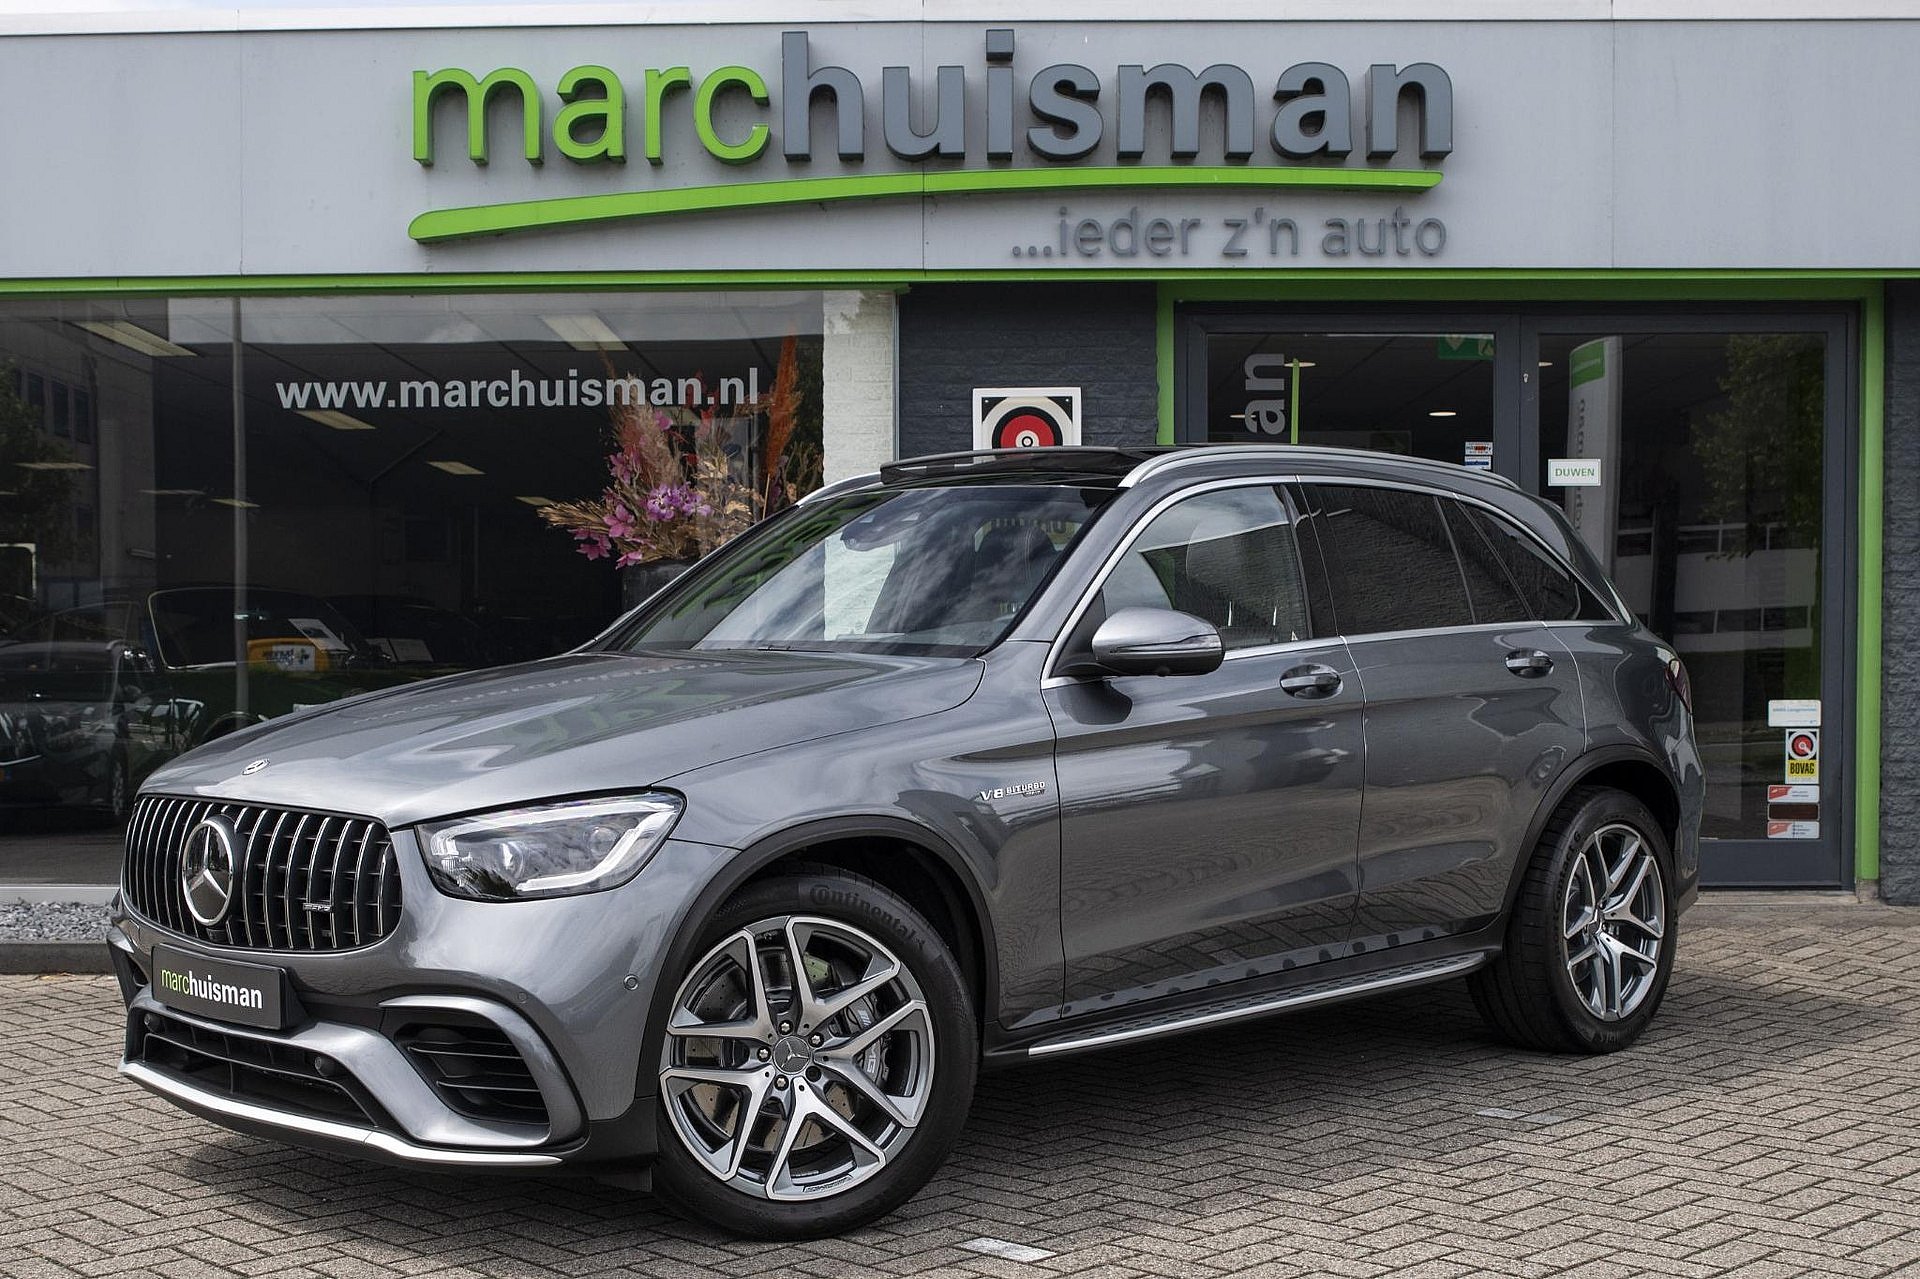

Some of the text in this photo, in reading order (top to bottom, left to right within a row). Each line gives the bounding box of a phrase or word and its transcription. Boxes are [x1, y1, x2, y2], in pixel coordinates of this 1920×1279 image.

[412, 29, 1454, 164] marchuisman
[1011, 206, 1447, 257] ...ieder z'n auto
[276, 367, 759, 410] www.marchuisman.nl
[1555, 468, 1595, 477] DUWEN
[1789, 762, 1815, 775] BOVAG
[980, 788, 1004, 801] V8
[1006, 781, 1046, 795] BITURBO
[809, 884, 917, 938] Continental
[161, 968, 263, 1009] marchuisman
